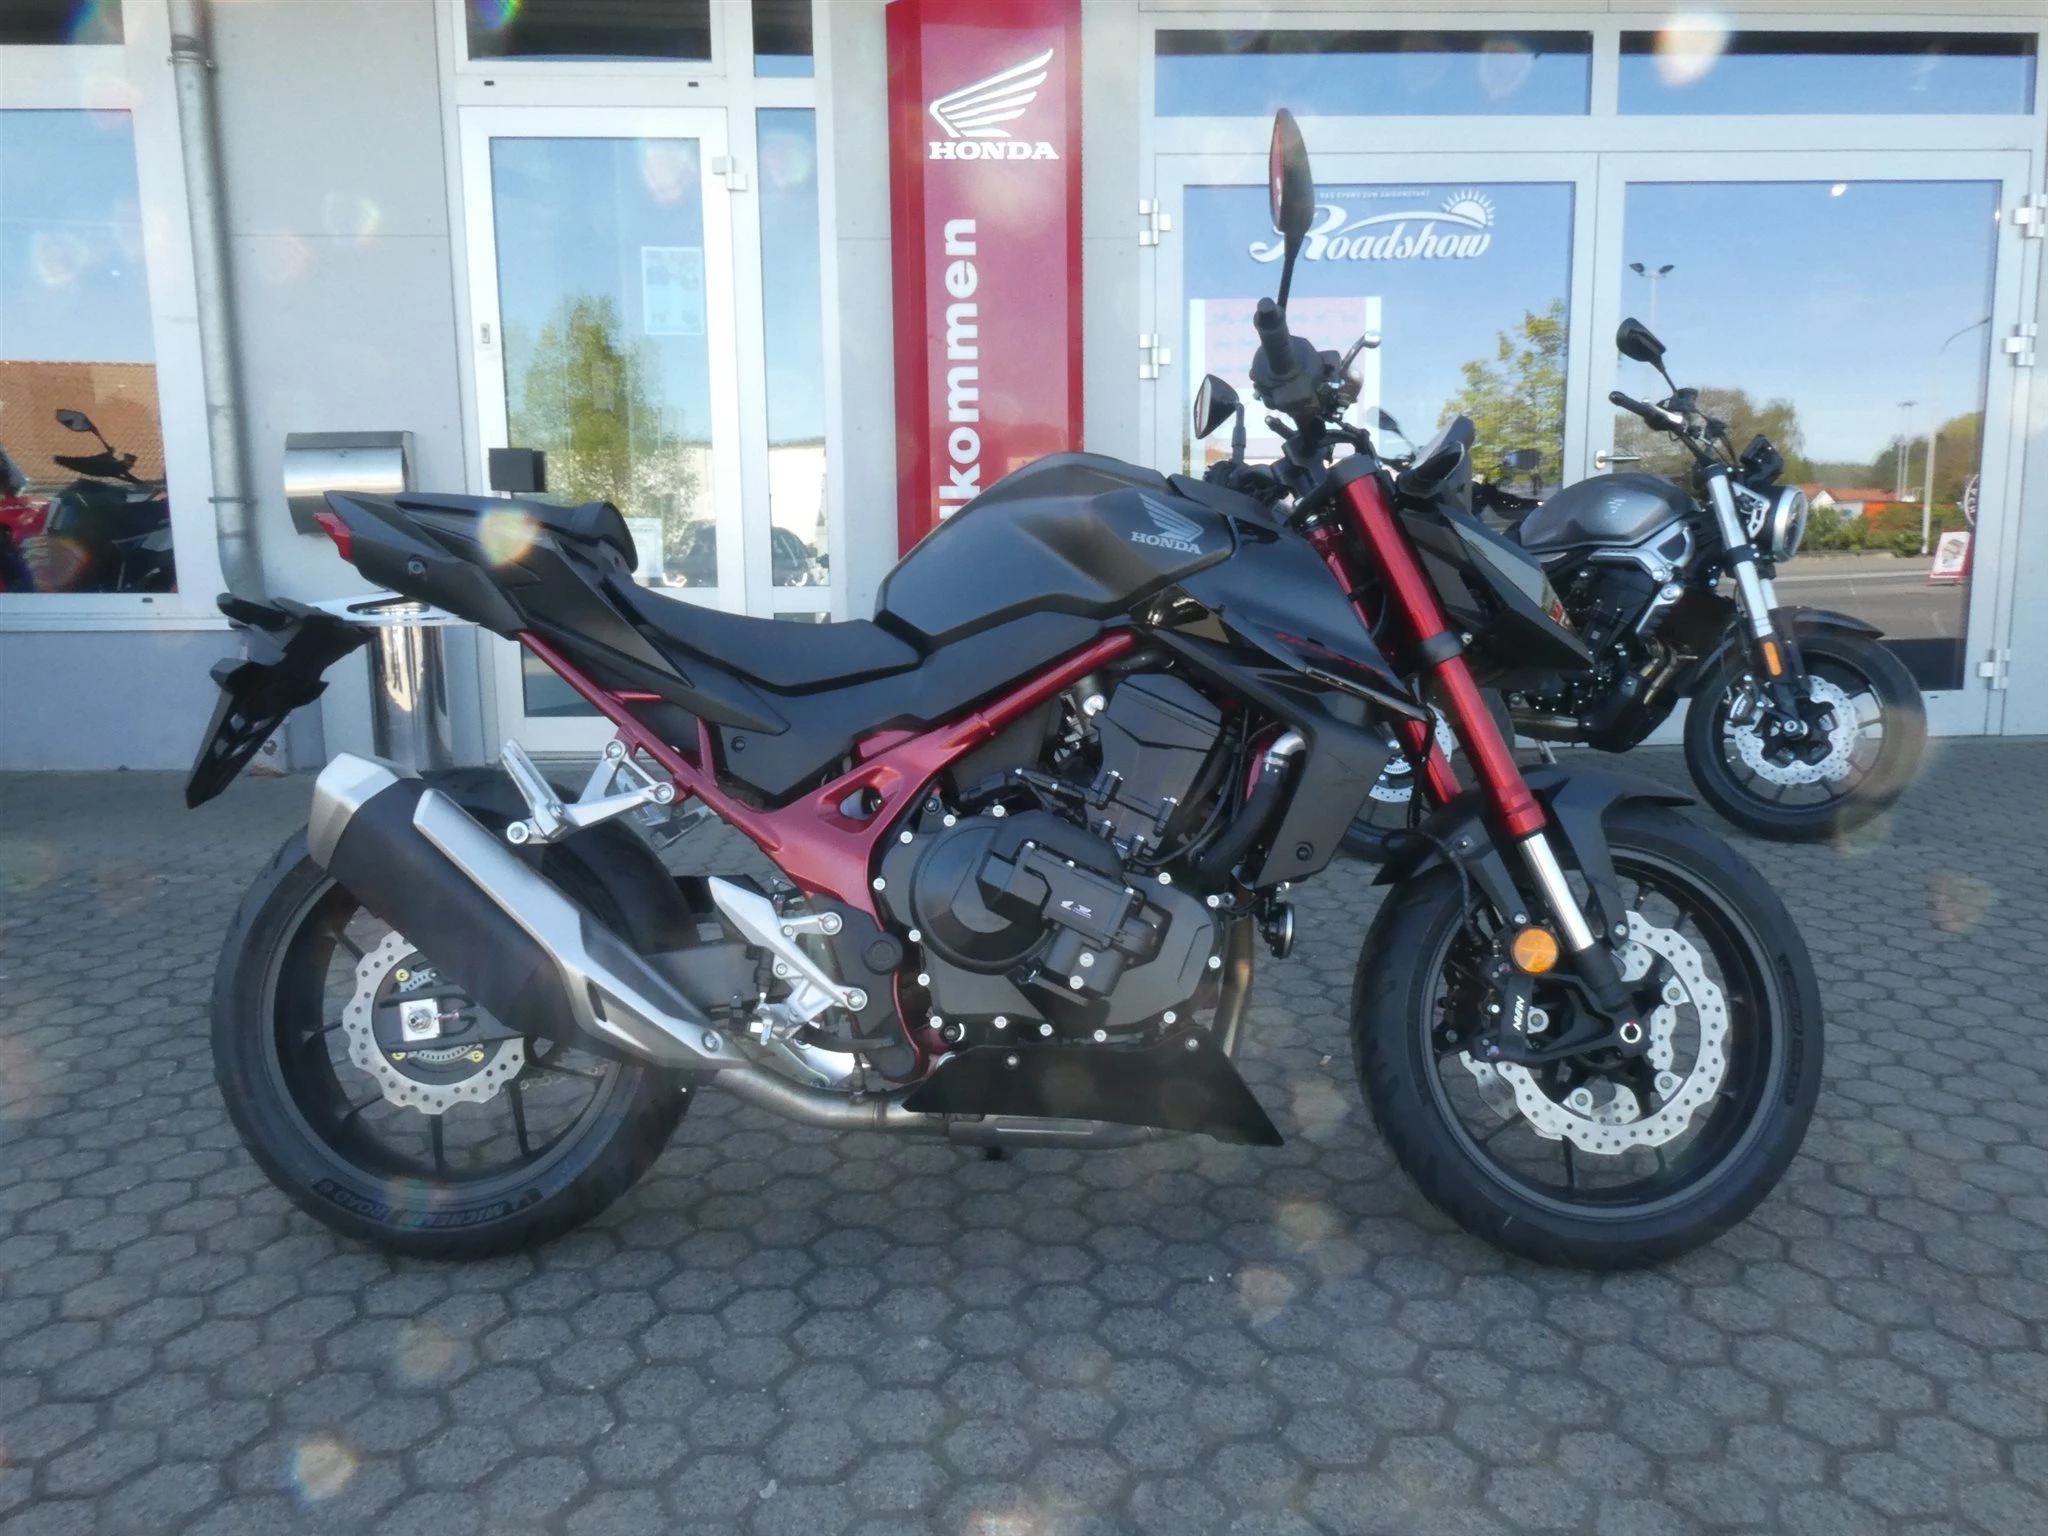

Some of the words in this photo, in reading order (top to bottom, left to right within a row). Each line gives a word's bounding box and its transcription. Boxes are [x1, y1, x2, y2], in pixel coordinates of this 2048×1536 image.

[929, 141, 1060, 159] HONDA
[1249, 204, 1490, 262] Roadshow
[1130, 531, 1203, 555] HONDA
